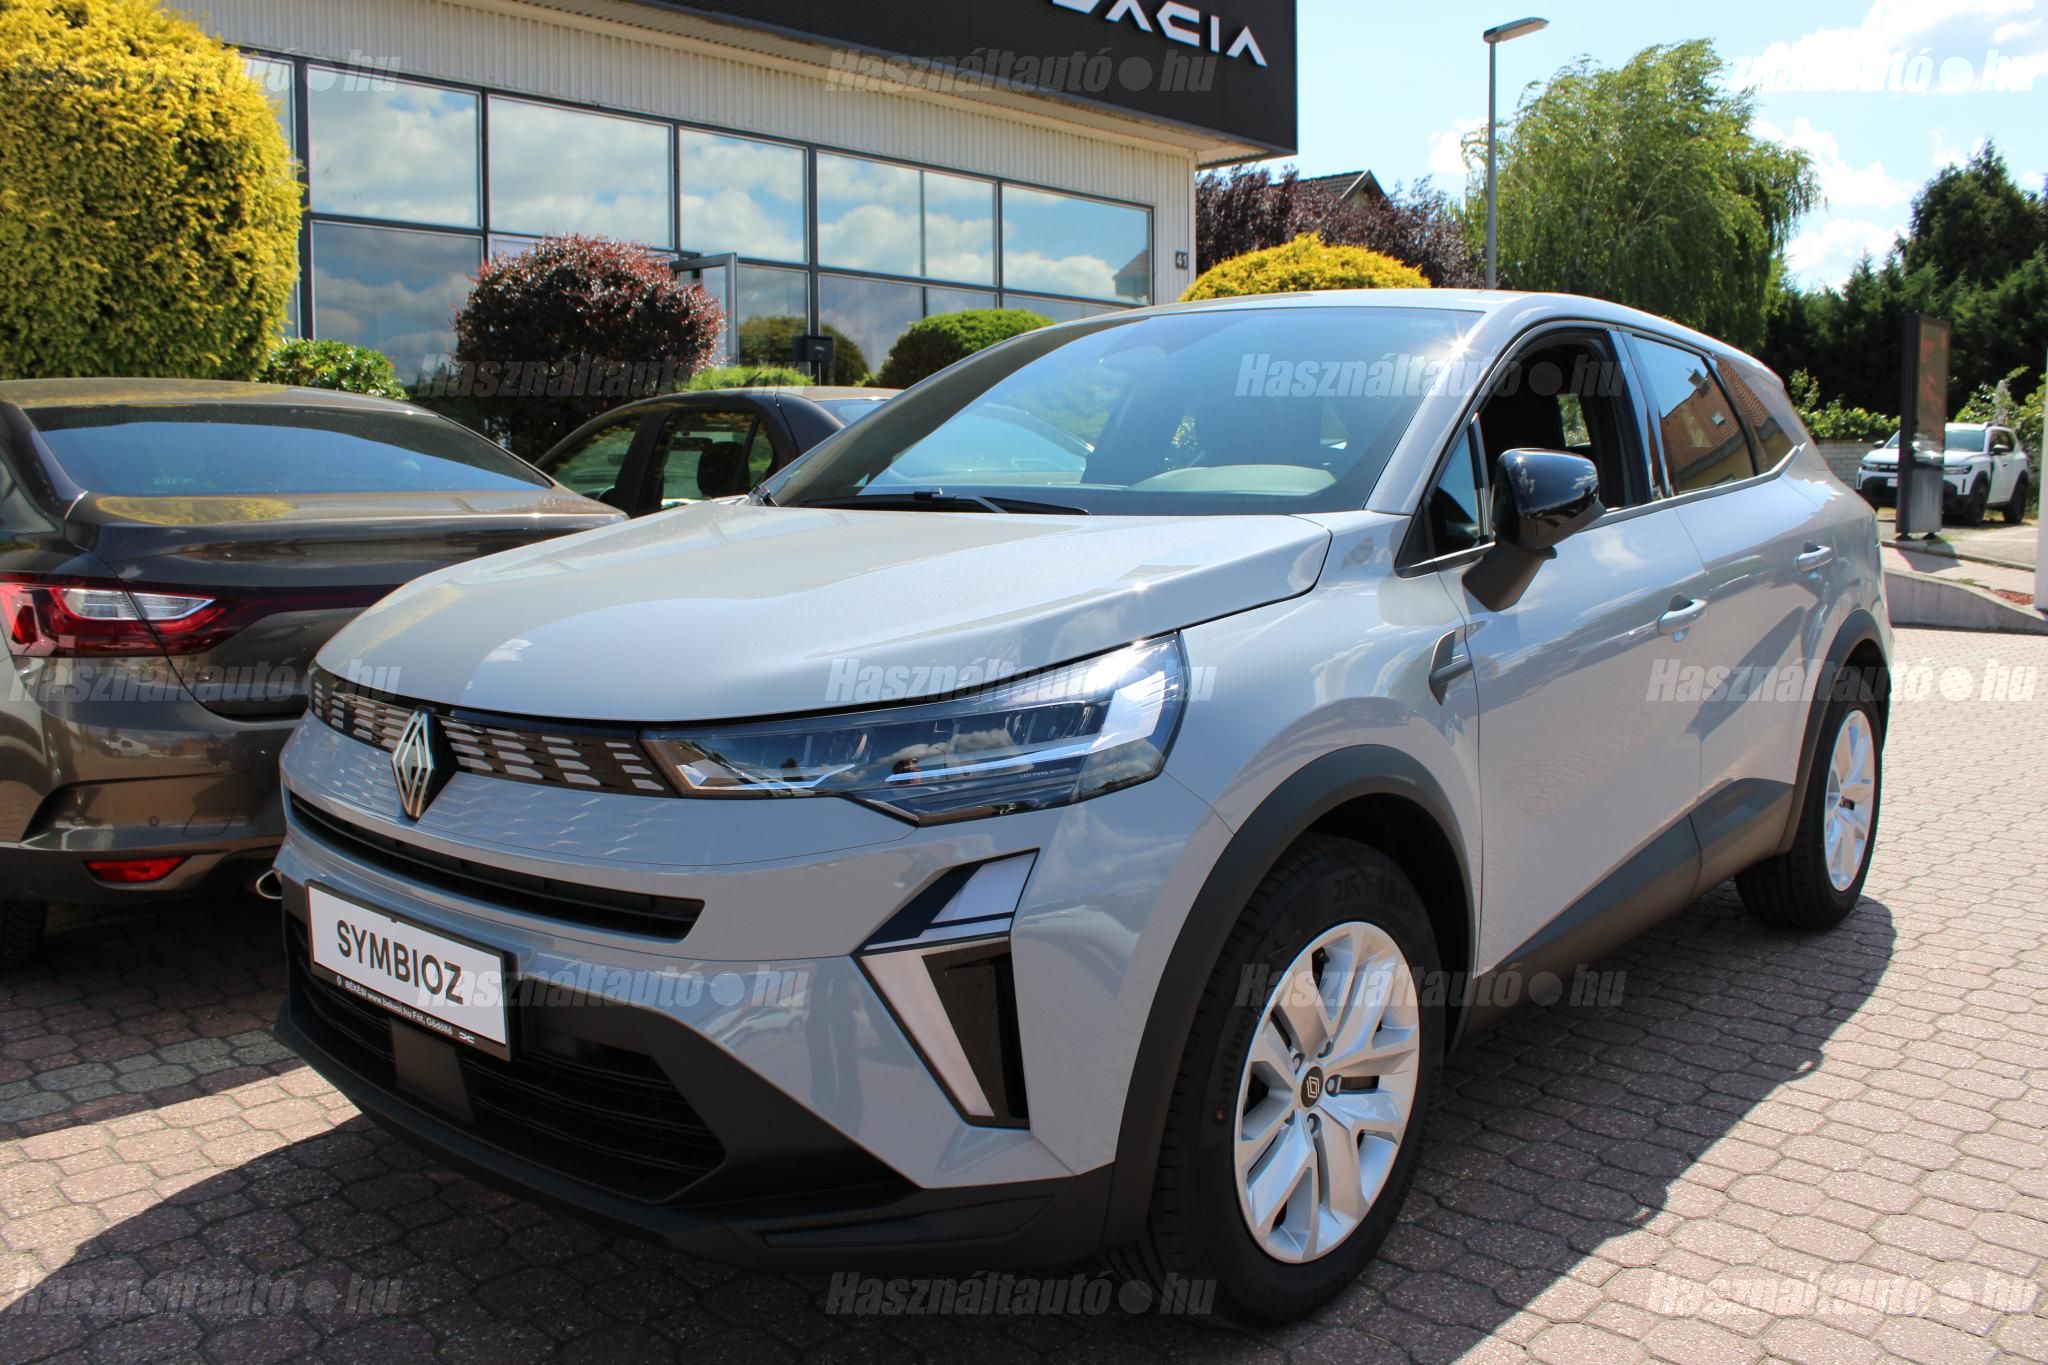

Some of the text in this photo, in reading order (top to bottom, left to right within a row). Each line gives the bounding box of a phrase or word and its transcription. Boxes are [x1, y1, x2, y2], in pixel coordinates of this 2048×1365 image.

[1050, 0, 1268, 67] ACIA
[1176, 254, 1187, 266] 41
[337, 919, 464, 1005] SYMBIOZ
